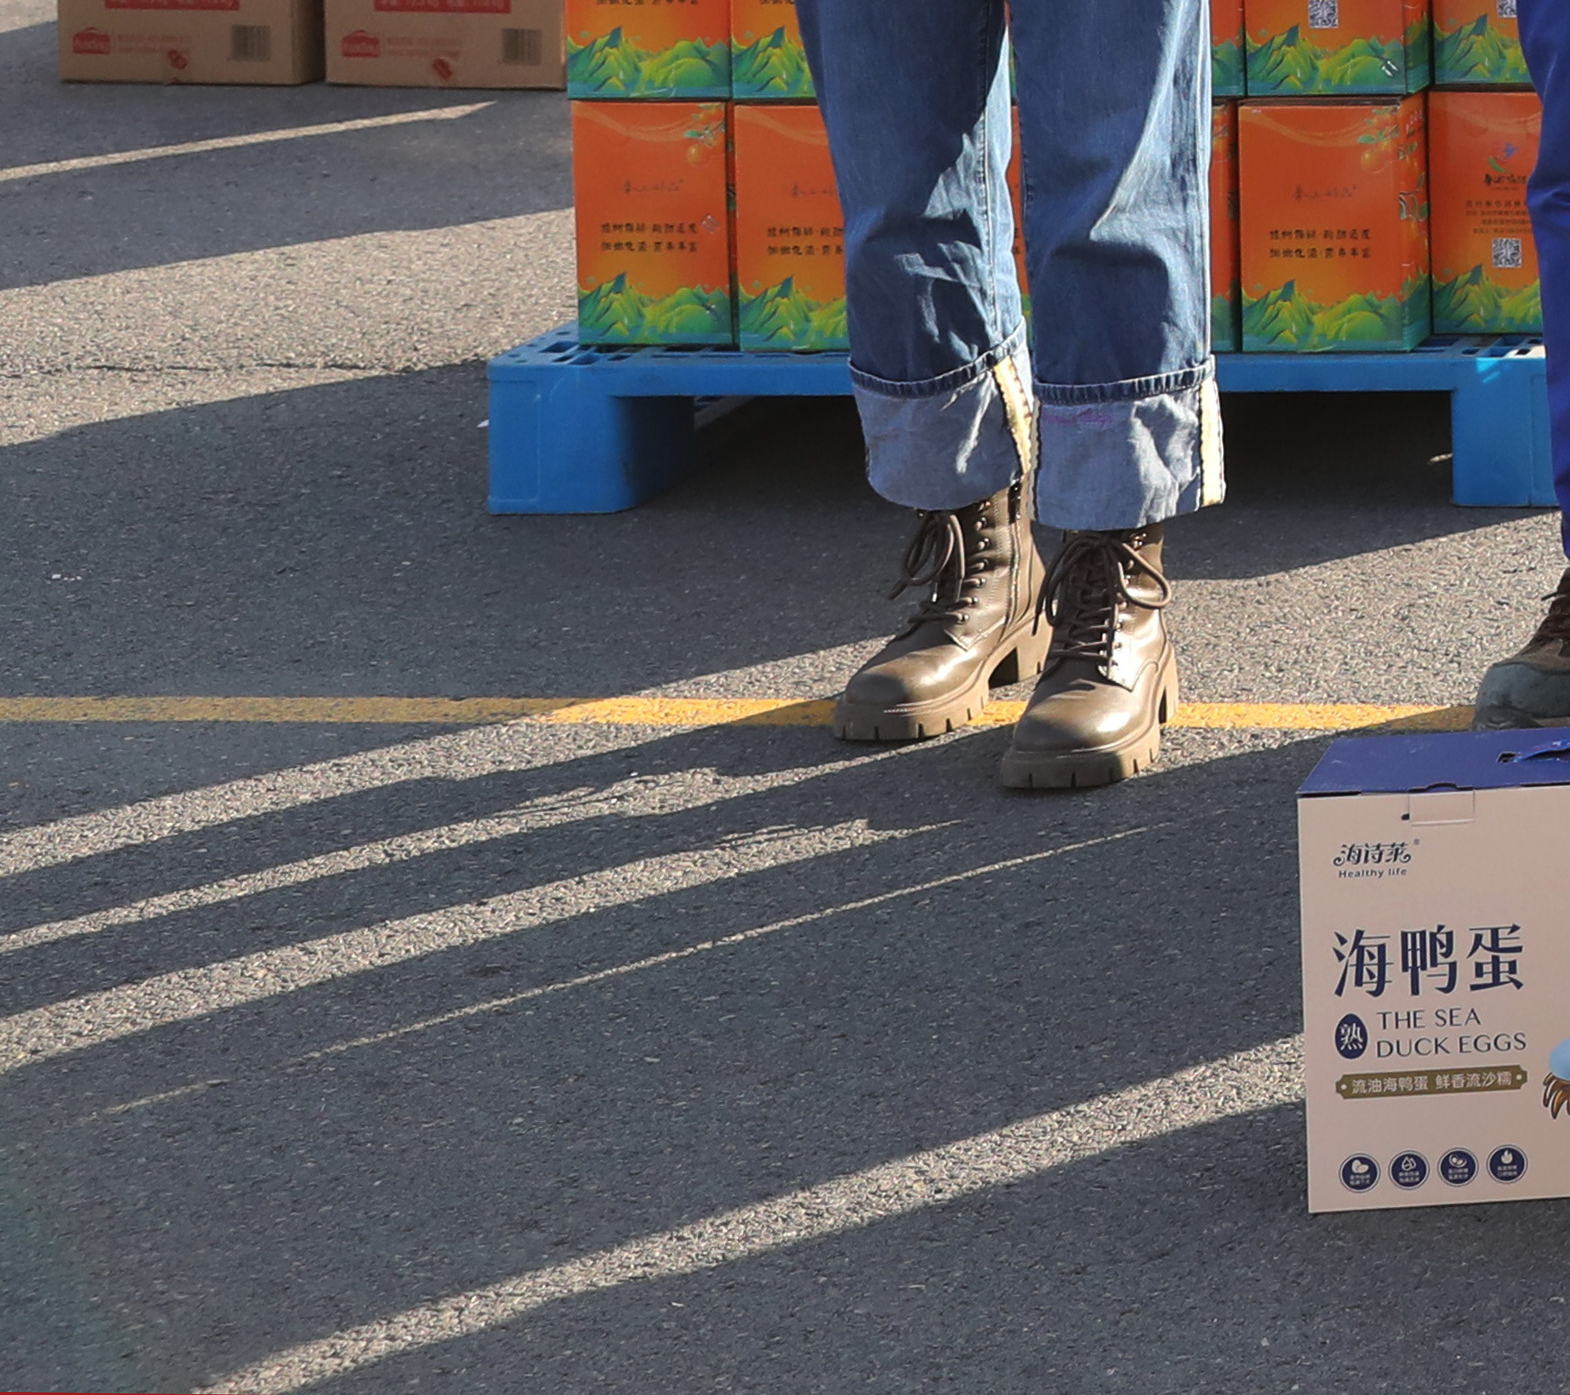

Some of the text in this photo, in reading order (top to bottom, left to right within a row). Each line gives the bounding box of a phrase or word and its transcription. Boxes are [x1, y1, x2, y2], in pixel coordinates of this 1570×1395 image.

[1338, 867, 1407, 879] Healthy life
[1333, 924, 1524, 998] 海鸭蛋
[1377, 1008, 1482, 1030] THE SEA
[1377, 1033, 1527, 1058] DUCK EGGS
